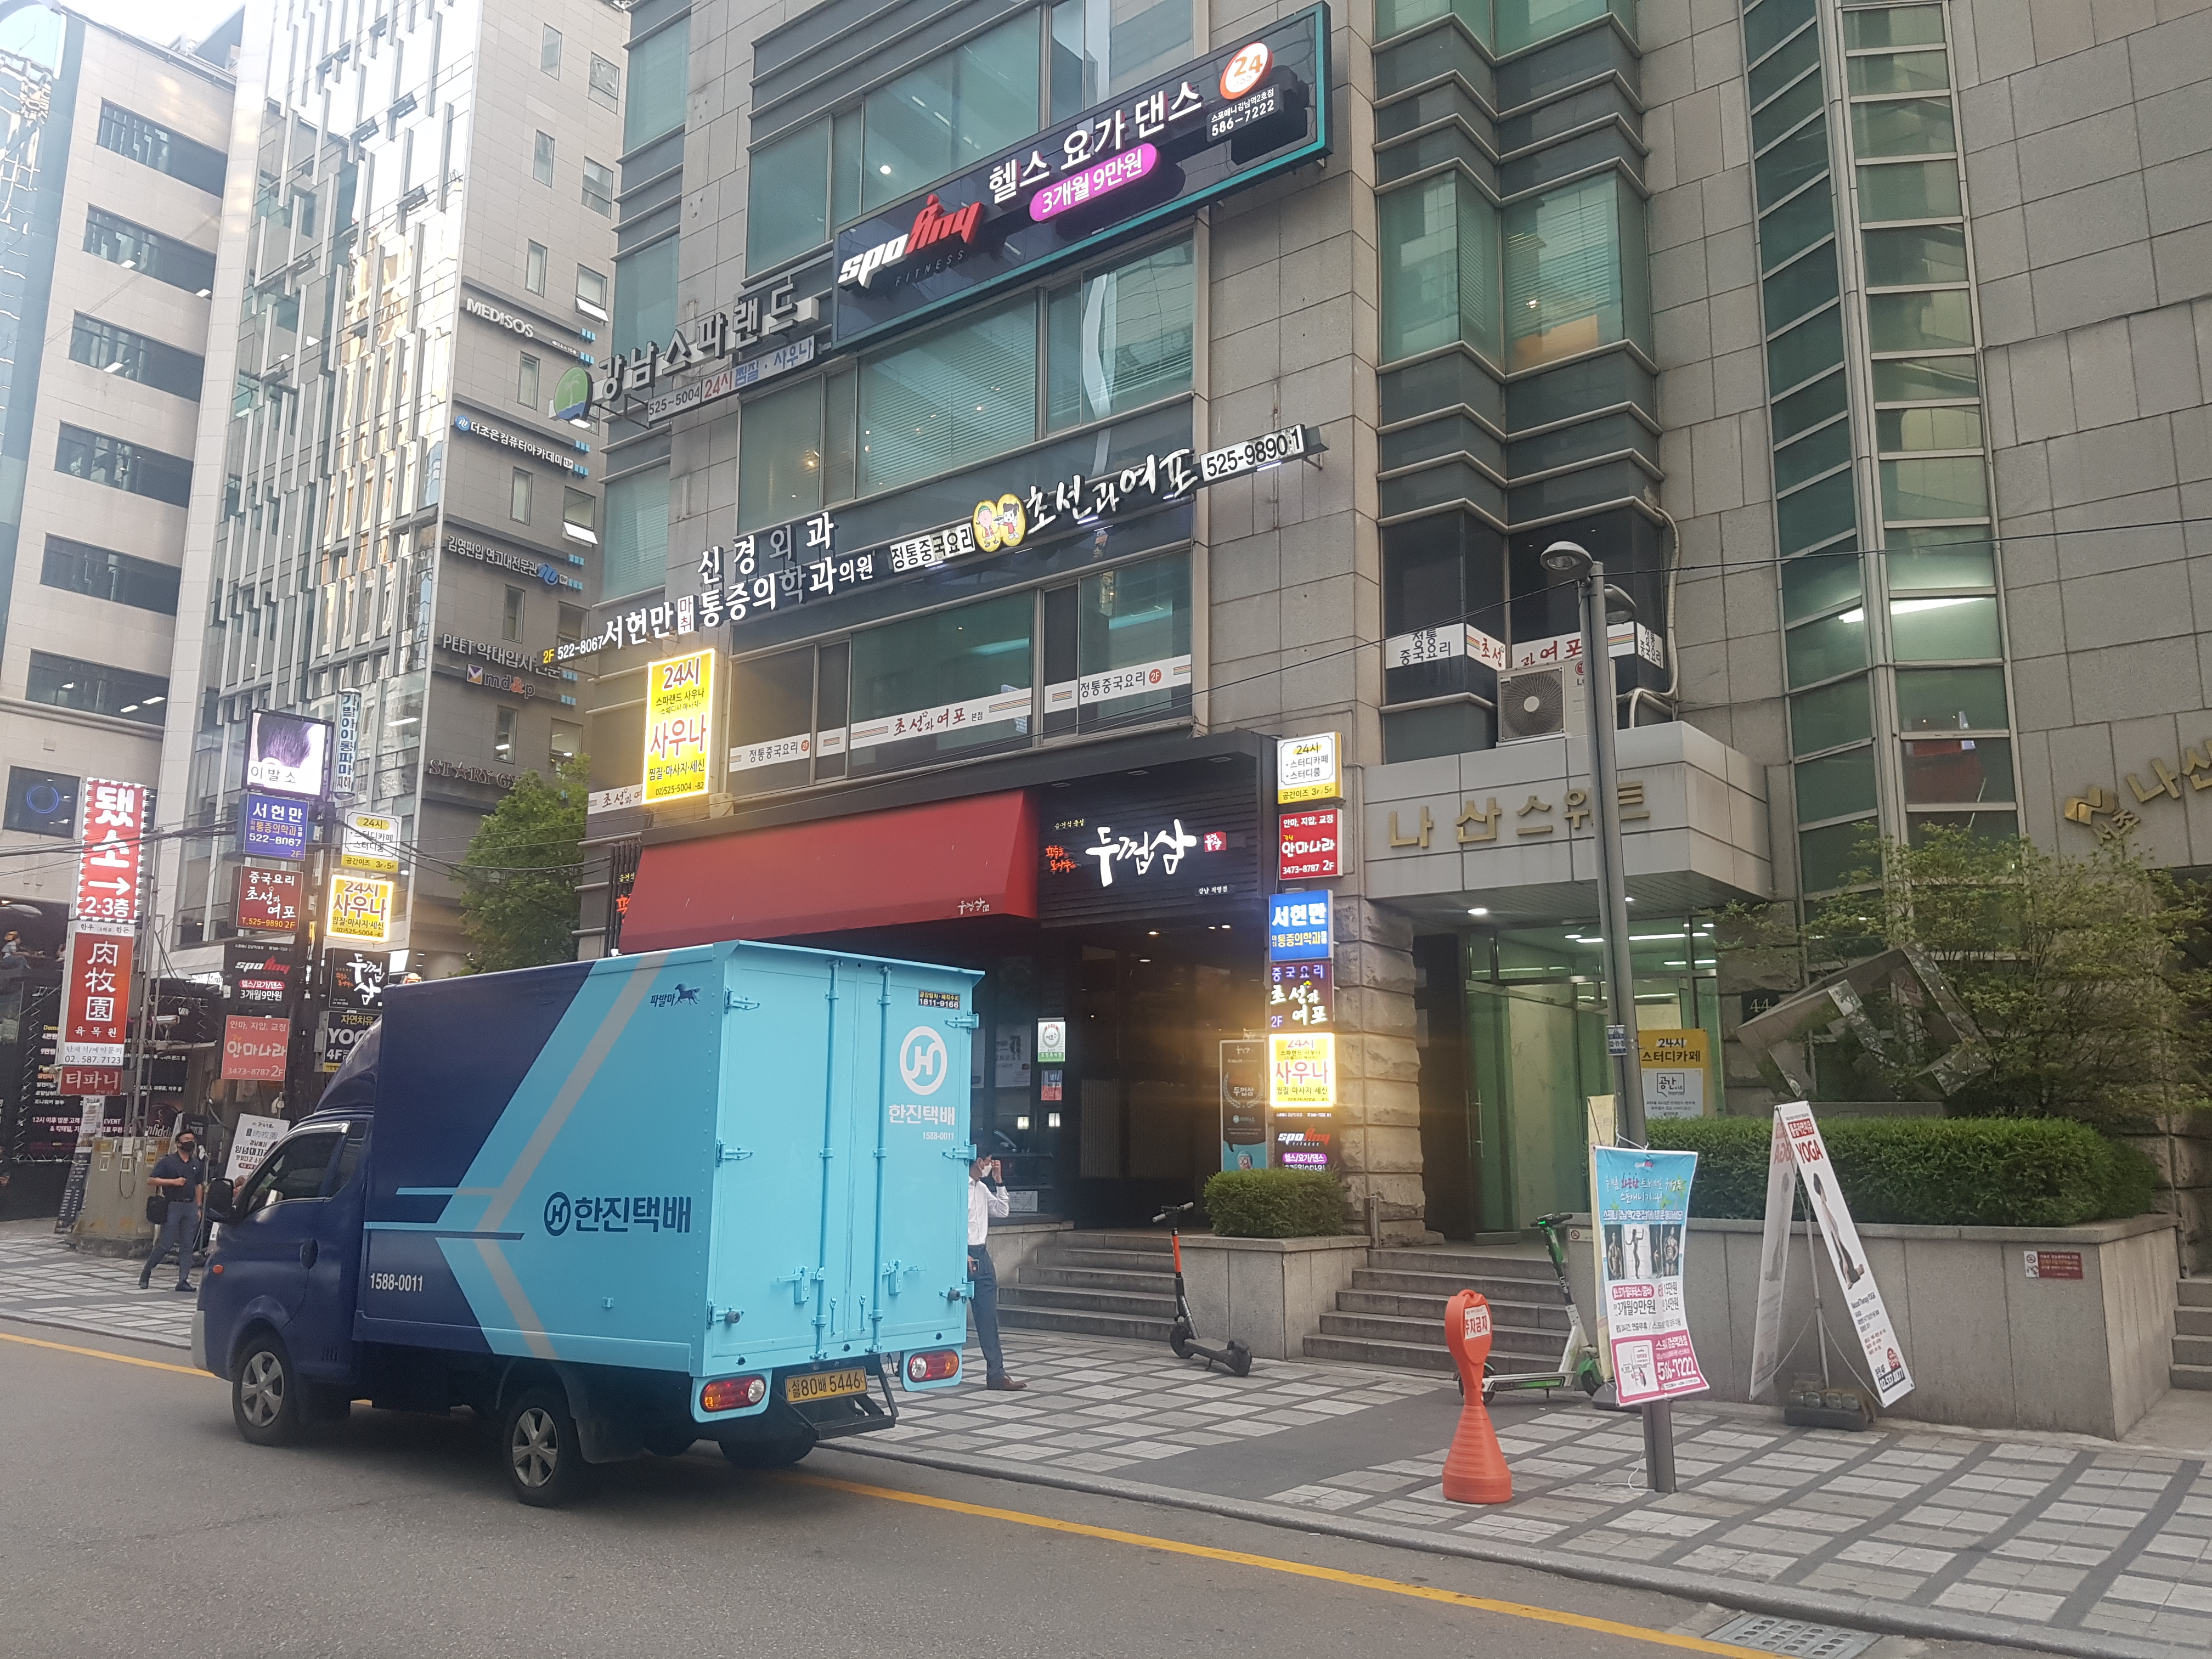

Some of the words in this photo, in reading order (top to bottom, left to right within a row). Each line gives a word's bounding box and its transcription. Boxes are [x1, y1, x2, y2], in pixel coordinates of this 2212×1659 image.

[1234, 54, 1263, 77] 24
[1211, 105, 1237, 123] 스포애니
[1212, 99, 1274, 136] 586-7222
[989, 151, 1050, 205] 헬스
[1061, 117, 1126, 170] 요가
[1134, 81, 1203, 132] 댄스
[1041, 172, 1091, 213] 3개월
[1094, 148, 1142, 192] 9만원
[895, 251, 964, 286] FITNESS
[466, 298, 533, 338] MEDISOS
[599, 281, 798, 402] 강남스파랜드
[704, 372, 733, 399] 24시
[774, 338, 813, 371] 사우나
[470, 421, 563, 467] 더조은컴퓨터아카데미
[1028, 448, 1198, 536] 초선과여포
[698, 512, 840, 585] 신경외과
[891, 522, 974, 569] 정통중국요리
[448, 535, 483, 560] 김영편입
[486, 548, 538, 577] 연고대전문관
[543, 649, 555, 664] 2F
[557, 635, 603, 661] 522-8067
[602, 602, 674, 650] 서헌만
[443, 633, 475, 655] PEET
[477, 642, 533, 673] 약대입시
[1400, 641, 1451, 666] 중국요리
[664, 658, 699, 689] 24시
[484, 673, 535, 699] md&p
[1080, 671, 1146, 698] 정통중국요리
[1151, 672, 1161, 681] 2F
[656, 693, 682, 707] 스파랜드
[684, 687, 705, 701] 사우나
[894, 708, 966, 735] 초선과여포
[971, 711, 983, 722] 본점
[650, 714, 707, 759] 사우나
[748, 740, 798, 764] 정통중국요리
[1296, 742, 1319, 755] 24시
[1290, 754, 1328, 768] 스터디카페
[251, 766, 296, 784] 이발소
[337, 776, 351, 789] 지하
[1290, 768, 1321, 780] 스터디룸
[656, 782, 692, 795] 02)525-5004
[1282, 789, 1309, 800] 공간이즈
[252, 802, 303, 823] 서헌만
[1283, 818, 1299, 828] 안마,
[1319, 814, 1334, 824] 교정
[256, 821, 297, 836] 통증의학과
[363, 817, 383, 830] 24시
[249, 833, 301, 847] 522-8067
[1282, 837, 1335, 858] 안마나라
[290, 849, 302, 857] 2F
[346, 856, 371, 867] 공간이즈
[1283, 864, 1319, 874] 3473-8787
[1323, 860, 1334, 871] 2F
[249, 871, 295, 887] 중국요리
[344, 880, 379, 898] 24시
[245, 886, 280, 905] 초선과
[267, 902, 296, 919] 여포
[332, 894, 387, 921] 사우나
[1272, 902, 1327, 927] 서헌만
[285, 920, 296, 929] 2F
[1278, 930, 1321, 948] 통증의학과
[84, 940, 119, 1022] 肉牧園
[1272, 964, 1324, 983] 중국요리
[650, 994, 675, 1008] 파발마
[919, 998, 959, 1008] 1811-9166
[1269, 984, 1321, 1005] 초선과
[1271, 1015, 1283, 1028] 2F
[1292, 1004, 1328, 1026] 여포
[75, 1026, 117, 1038] 육목원
[227, 1040, 286, 1058] 안마나라
[1287, 1039, 1314, 1048] 24시
[1658, 1037, 1684, 1048] 24시
[326, 1048, 343, 1060] 4F
[1641, 1050, 1701, 1062] 스터디카페
[65, 1070, 118, 1090] 티파니
[227, 1067, 270, 1076] 3473-8787
[271, 1064, 284, 1077] 2F
[1276, 1061, 1328, 1085] 사우나
[1233, 1086, 1254, 1096] 두껍삼
[888, 1104, 955, 1126] 한진택배
[922, 1130, 954, 1140] 1588-0011
[1795, 1139, 1824, 1164] YOGA
[575, 1197, 692, 1233] 한진택배
[370, 1273, 423, 1291] 1588-0011
[1465, 1315, 1488, 1336] 주차금지
